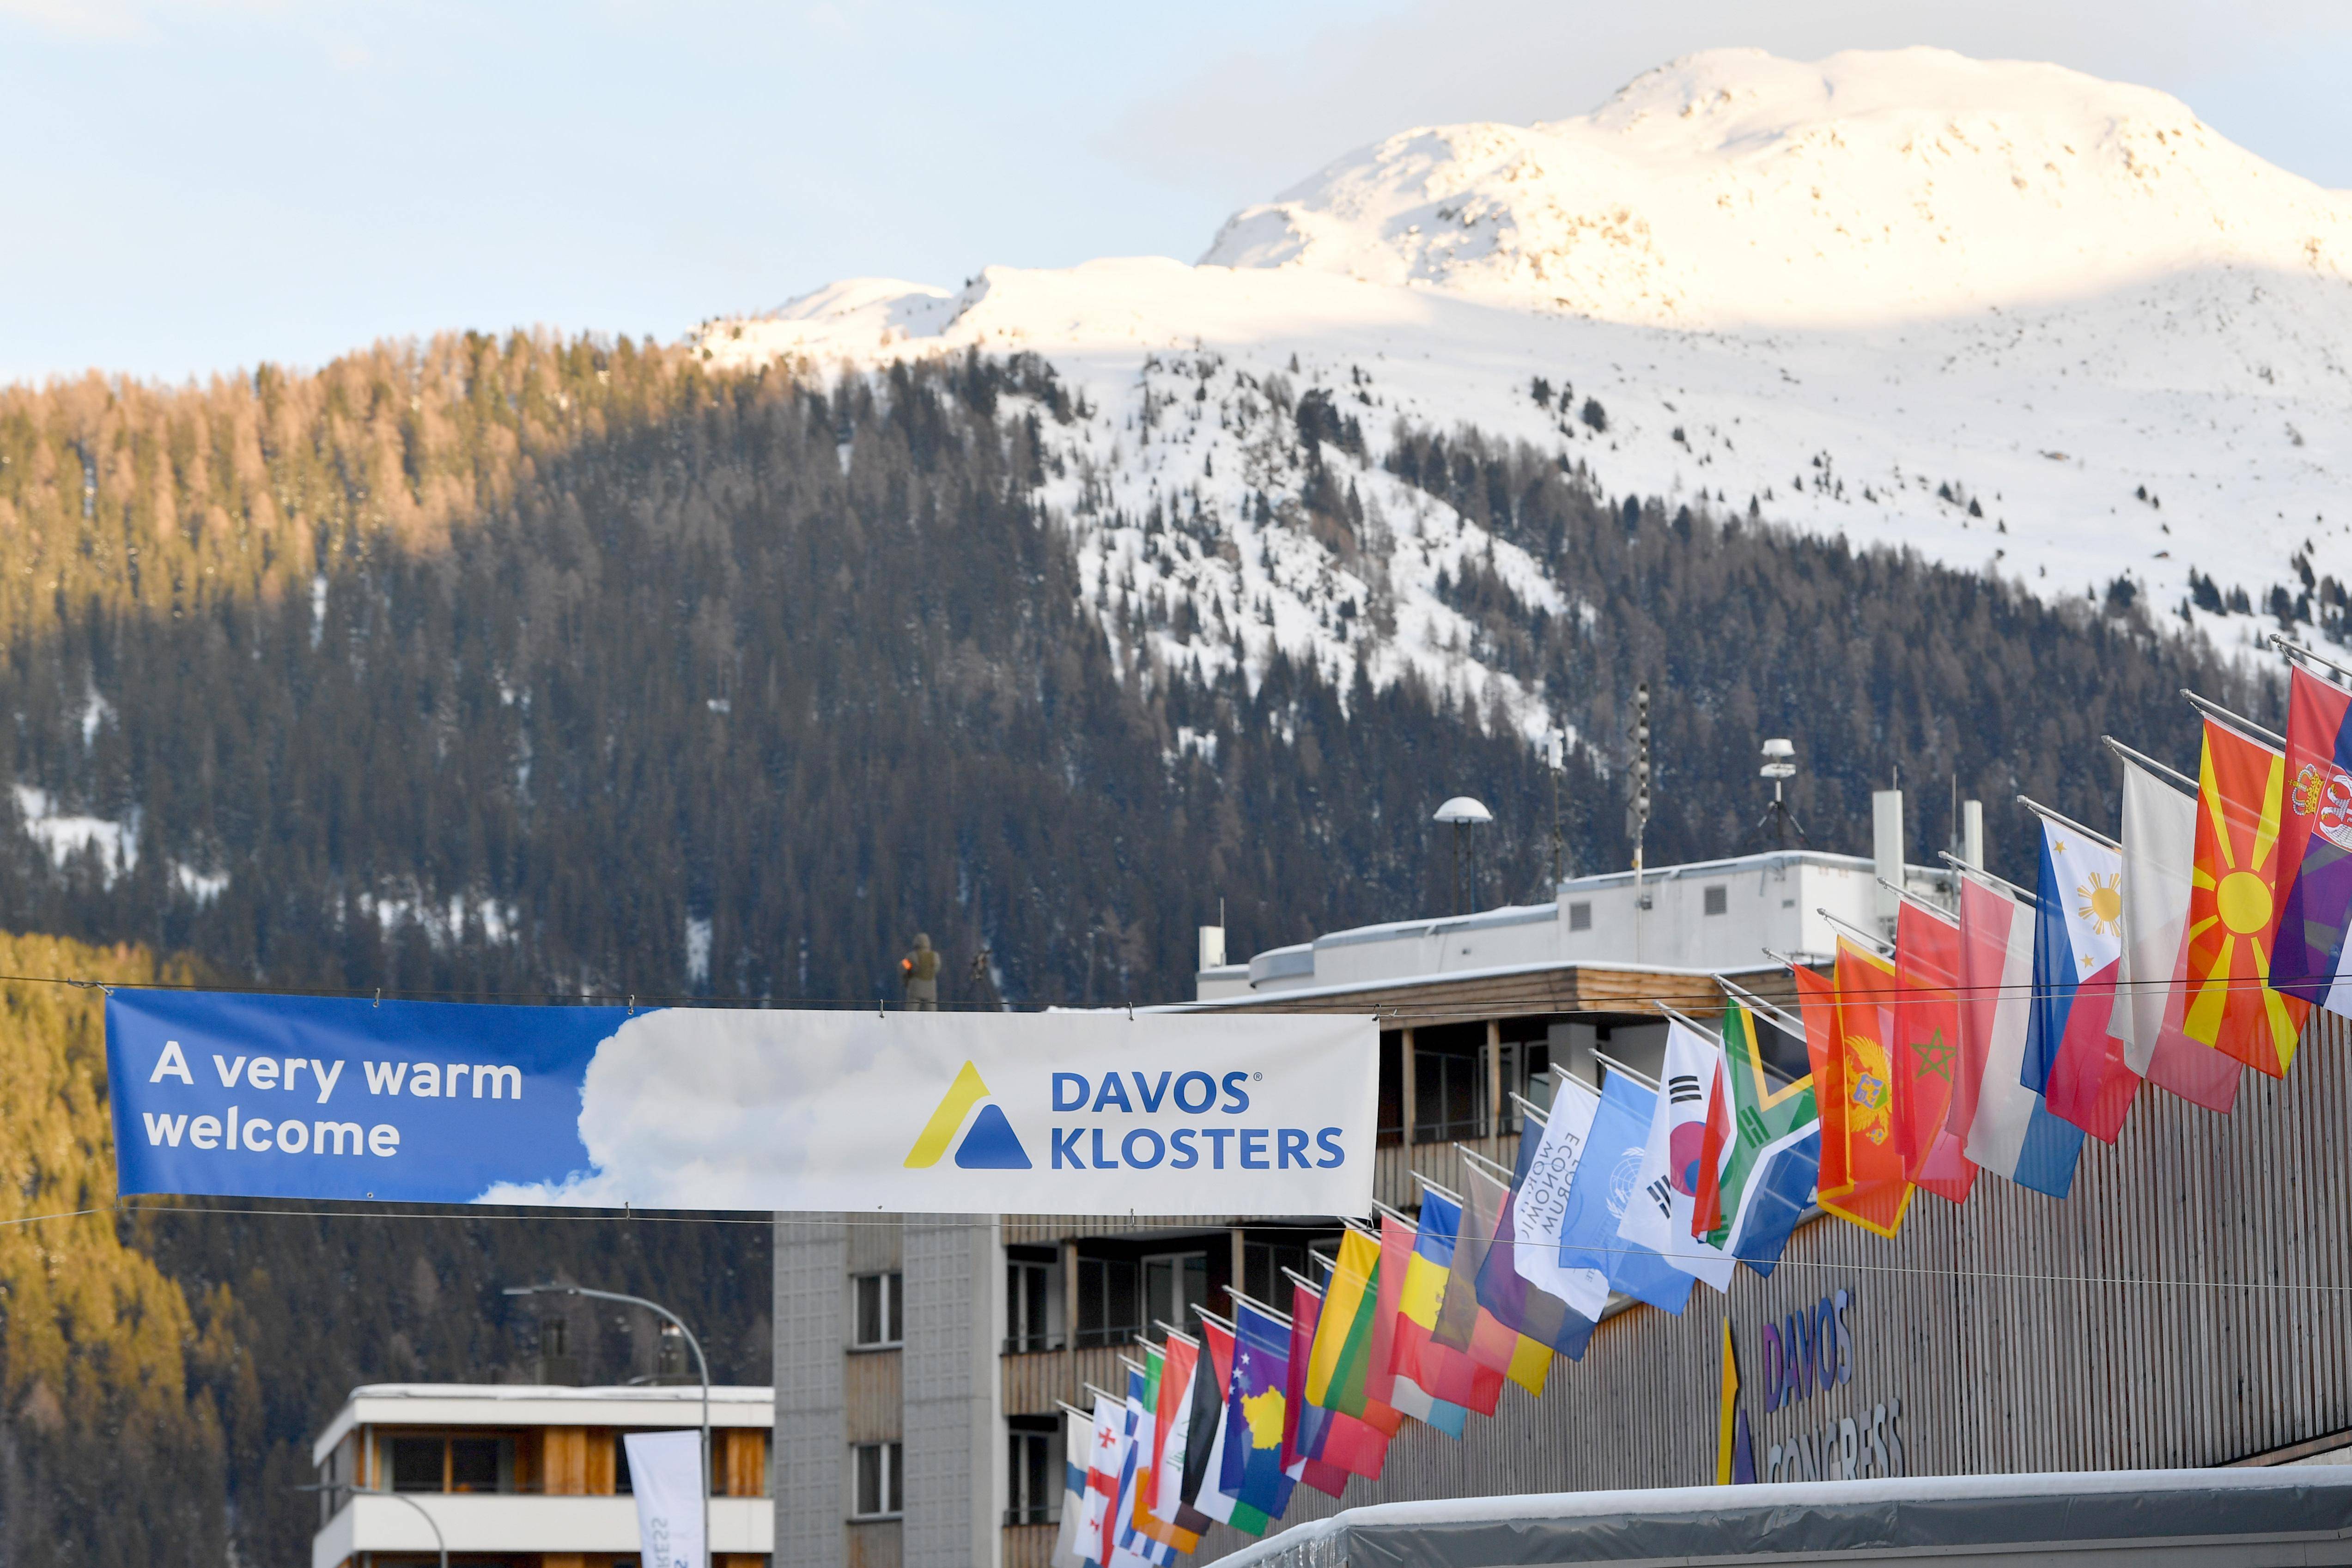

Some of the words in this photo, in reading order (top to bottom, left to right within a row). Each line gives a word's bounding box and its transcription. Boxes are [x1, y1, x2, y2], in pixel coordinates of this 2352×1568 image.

[149, 1040, 194, 1085] A
[213, 1055, 345, 1104] very
[363, 1061, 522, 1100] warm
[142, 1106, 400, 1157] welcome
[1051, 1127, 1344, 1170] KLOSTERS
[1762, 1288, 1853, 1413] DAVOS
